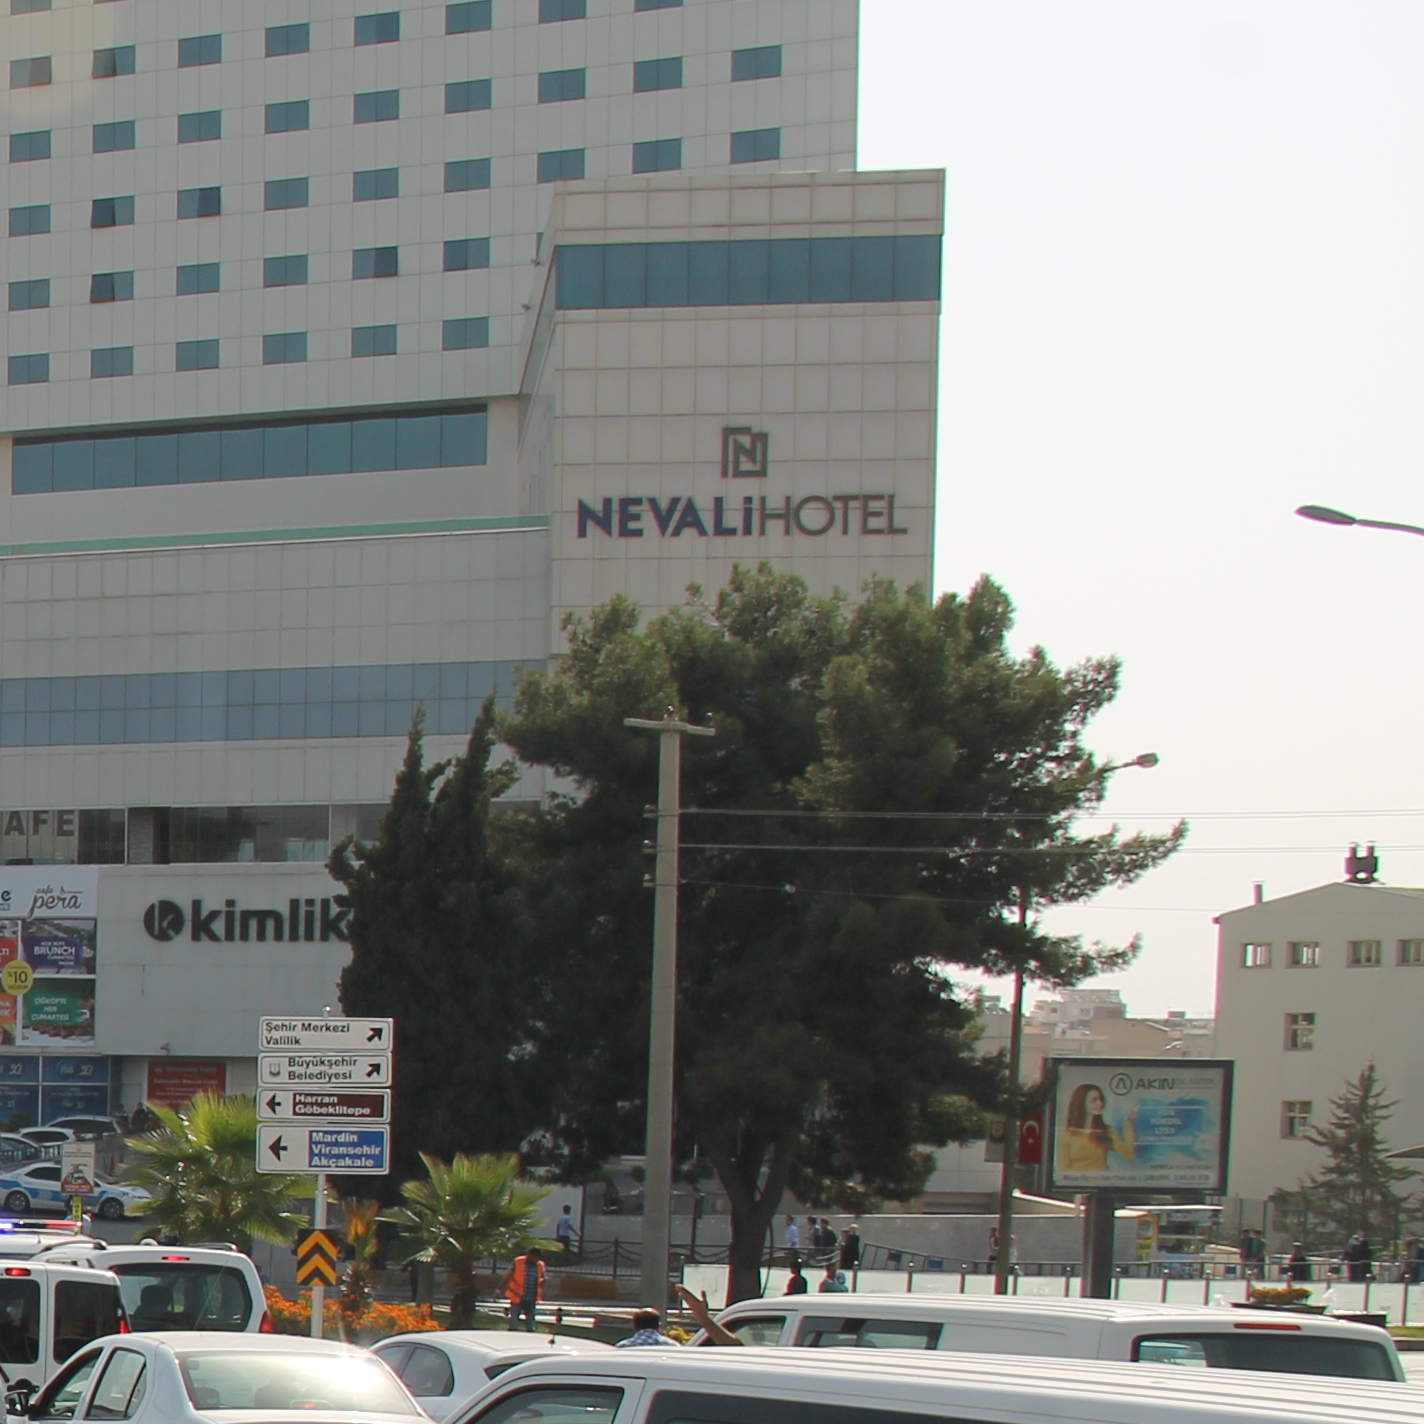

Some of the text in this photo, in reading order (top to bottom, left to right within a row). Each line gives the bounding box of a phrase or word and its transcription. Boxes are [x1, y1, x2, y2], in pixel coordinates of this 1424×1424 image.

[25, 893, 83, 922] pera
[190, 898, 352, 942] kimlik
[34, 946, 76, 955] BRUNCH
[265, 1022, 350, 1035] Şehir Merkezi
[265, 1035, 301, 1046] Valilik
[288, 1056, 358, 1070] Büyükşehir
[288, 1070, 352, 1084] Belediyesi
[1134, 1078, 1175, 1090] AKIN
[295, 1094, 338, 1104] Harran
[295, 1104, 371, 1117] Göbeklitepe
[311, 1132, 358, 1143] Mardin
[310, 1156, 374, 1169] Akçakale
